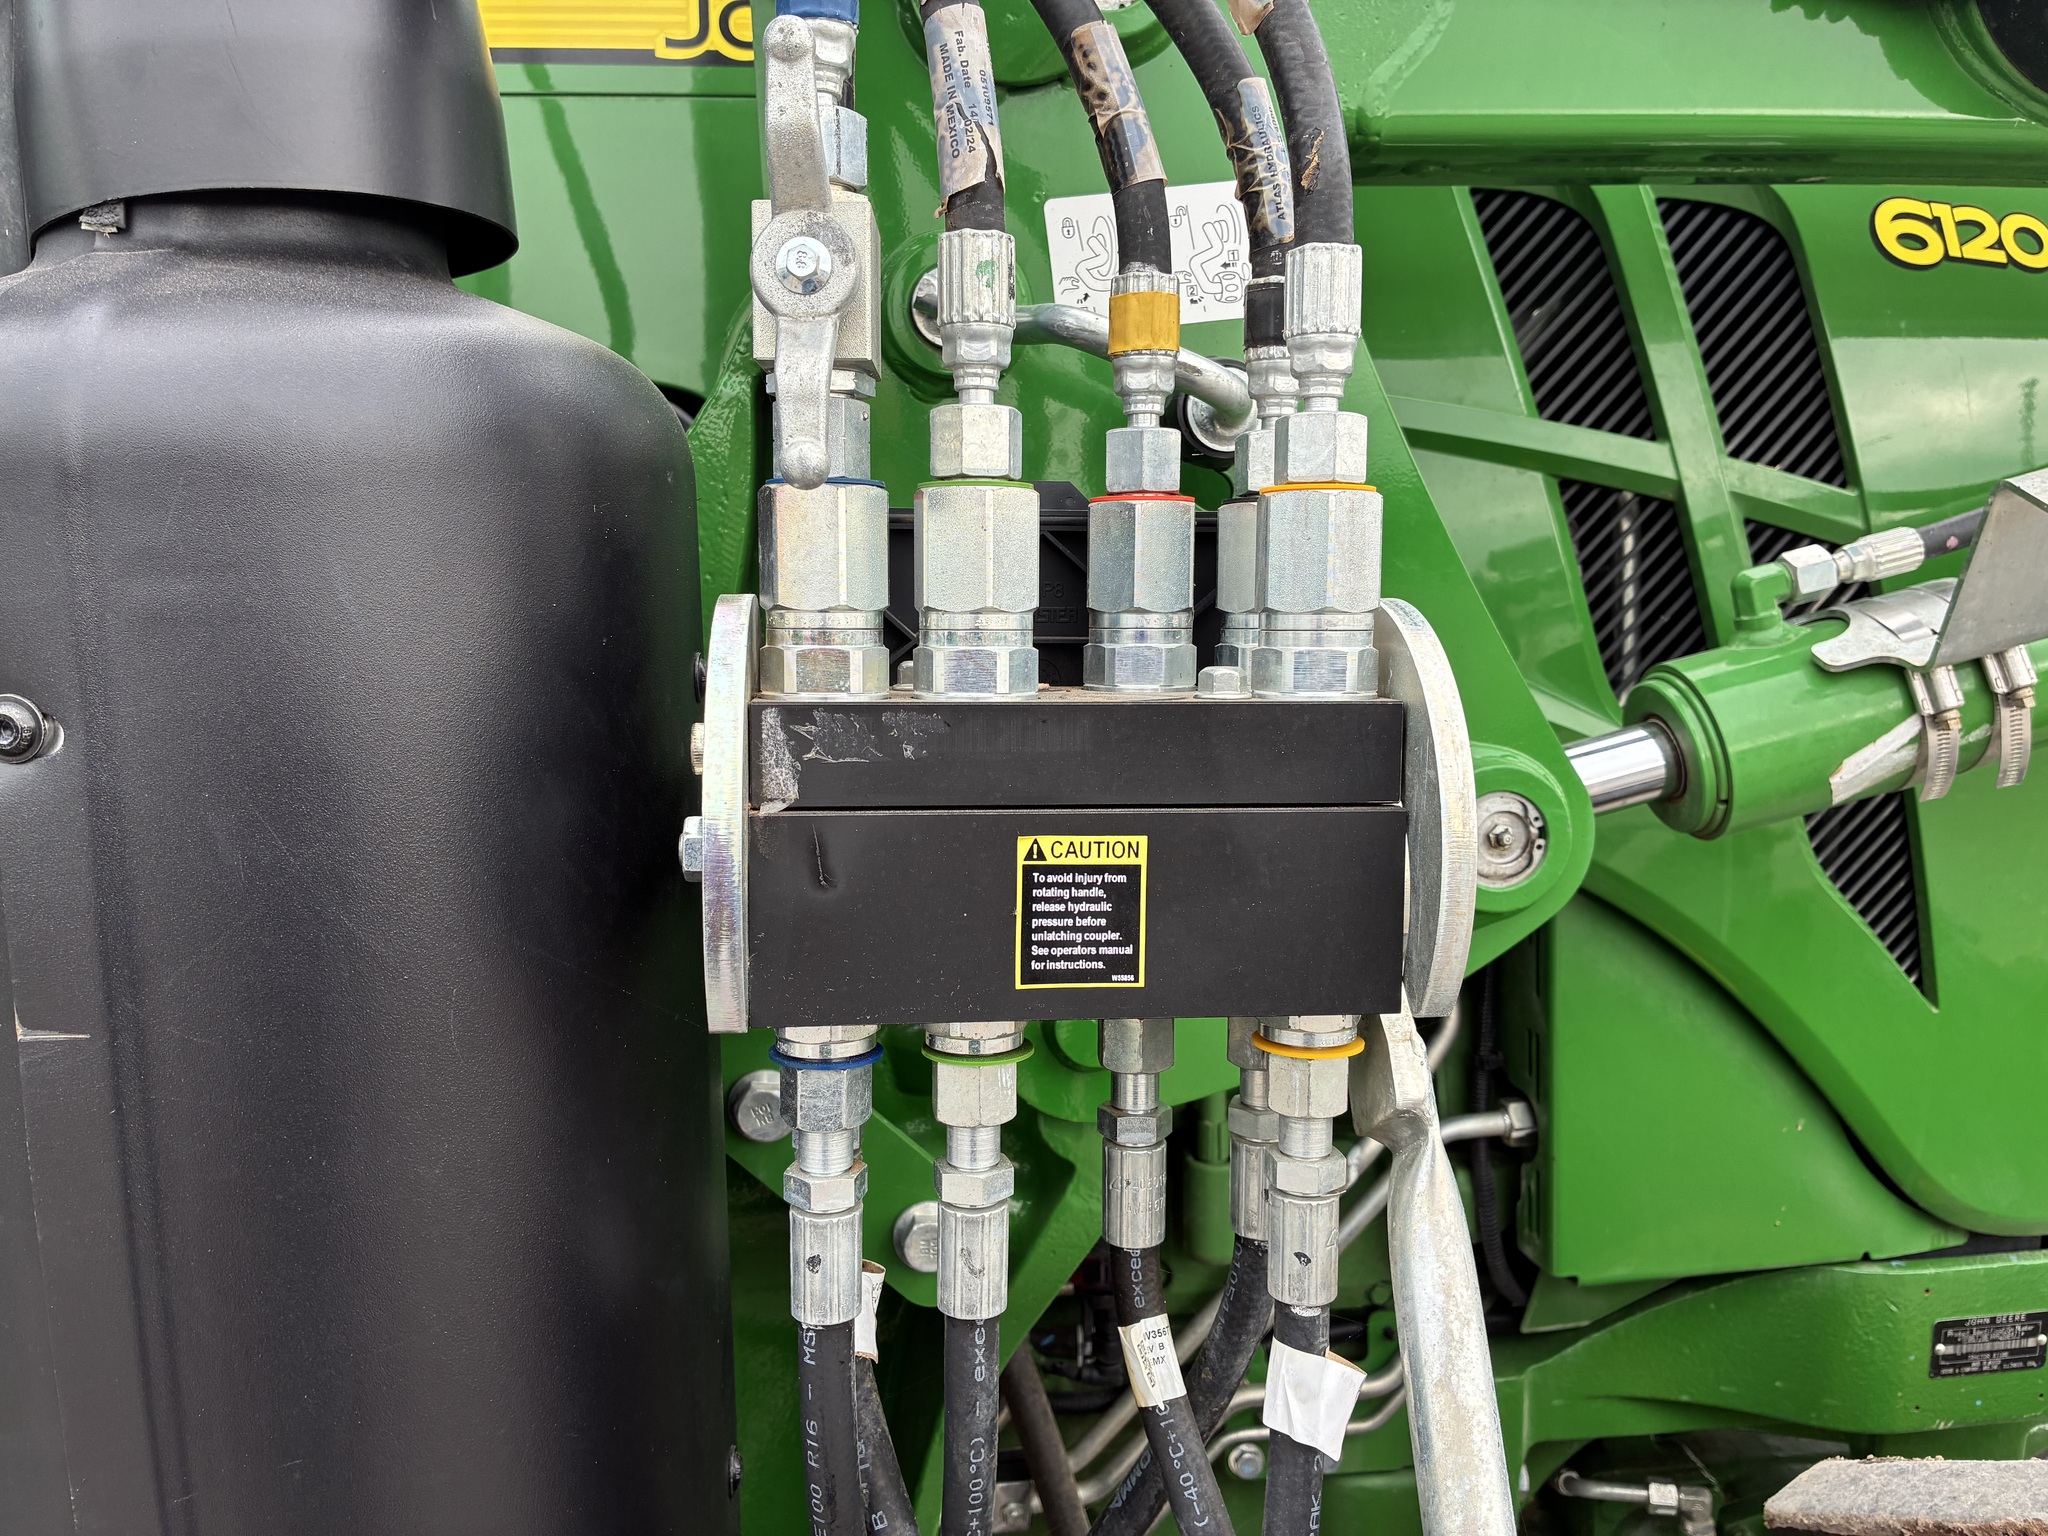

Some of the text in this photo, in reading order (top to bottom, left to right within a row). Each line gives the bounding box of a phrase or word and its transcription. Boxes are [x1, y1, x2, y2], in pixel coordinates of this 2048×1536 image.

[954, 30, 965, 58] Fab.
[960, 60, 971, 89] Date
[939, 43, 960, 159] MADE IN MEXICO
[1251, 105, 1286, 220] ATLAS HYDRAULICS
[1870, 197, 2048, 273] 6120
[1051, 840, 1140, 859] CAUTION
[1032, 872, 1127, 885] To avoid injury from
[1032, 887, 1107, 899] rotating handle,
[1031, 901, 1113, 914] release hydraulic
[1031, 916, 1107, 929] pressure before
[1031, 930, 1123, 943] unlatching coupler.
[1031, 944, 1133, 957] See operators manual
[1031, 959, 1106, 970] for instructions.
[1964, 1314, 2027, 1327] JOHN DEERE
[803, 1324, 816, 1366] MS
[1158, 1342, 1165, 1351] B
[806, 1418, 820, 1469] R16
[1108, 1447, 1153, 1509] OMMA
[1309, 1490, 1321, 1536] AK
